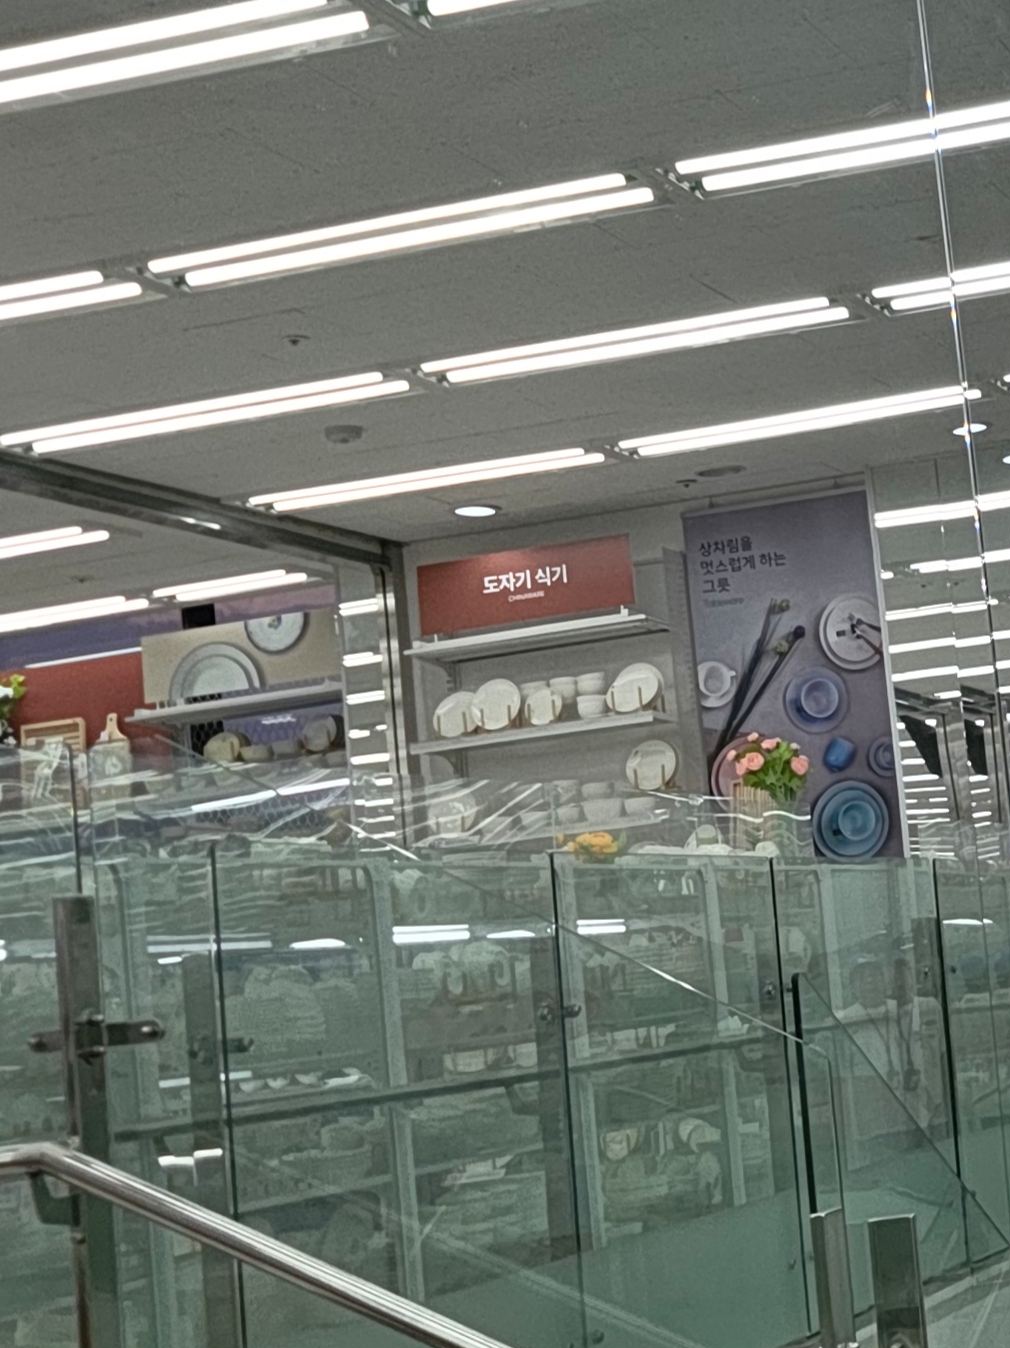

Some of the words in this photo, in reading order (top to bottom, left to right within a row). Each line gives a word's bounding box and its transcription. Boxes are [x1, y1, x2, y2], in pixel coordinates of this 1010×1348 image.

[699, 535, 752, 557] 상차림을
[700, 554, 756, 575] 멋스럽게
[759, 552, 786, 567] 하는
[482, 569, 531, 594] 도자기
[535, 564, 568, 586] 식기
[702, 577, 731, 593] 그릇
